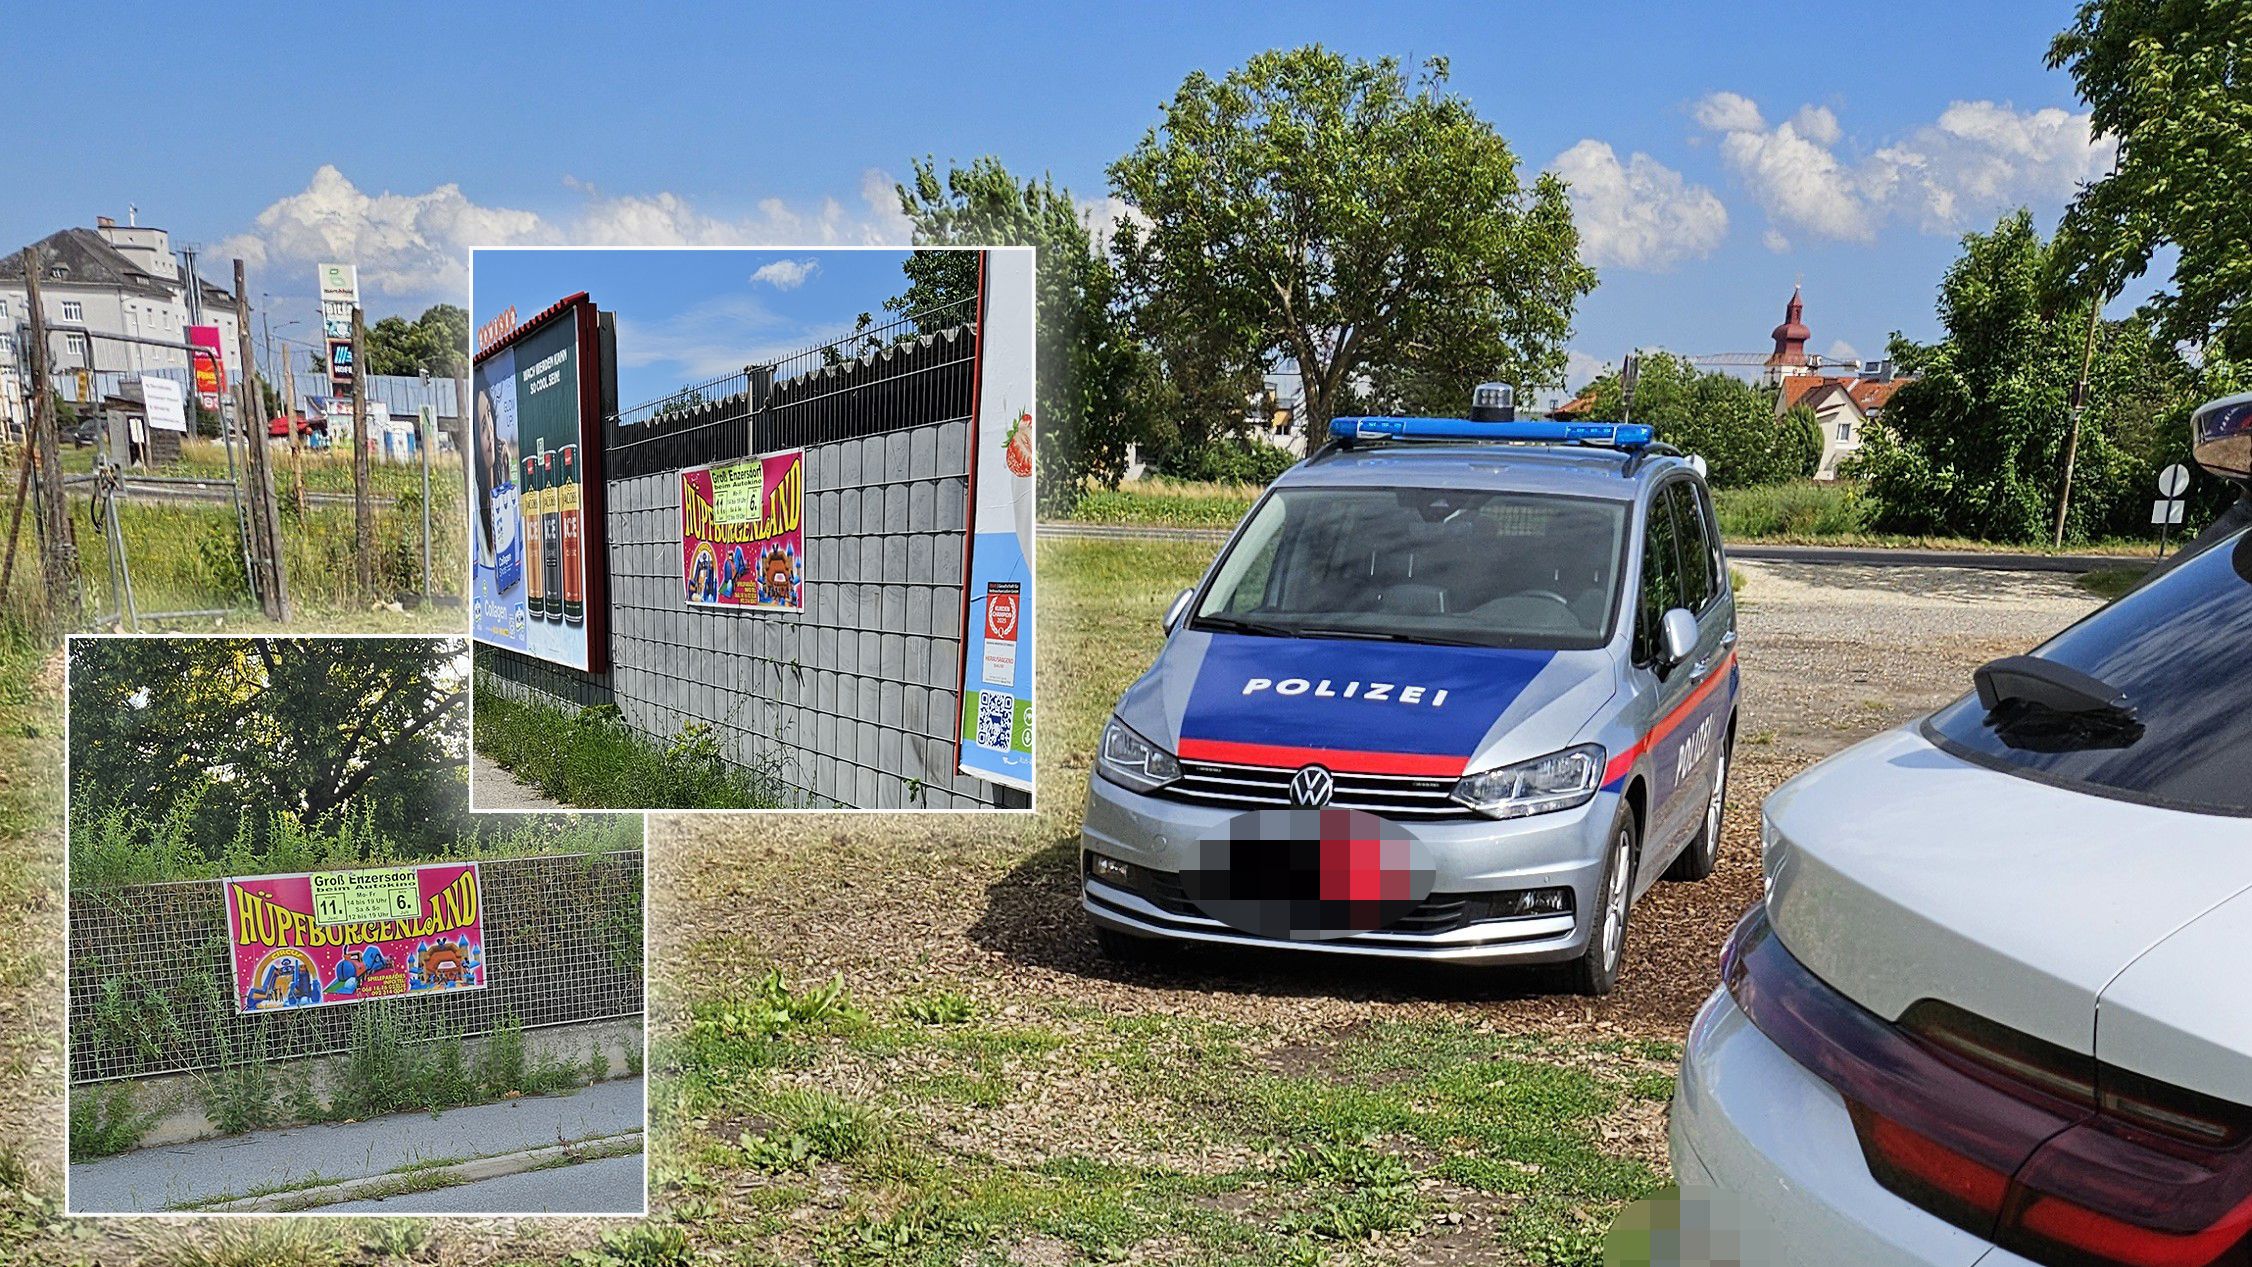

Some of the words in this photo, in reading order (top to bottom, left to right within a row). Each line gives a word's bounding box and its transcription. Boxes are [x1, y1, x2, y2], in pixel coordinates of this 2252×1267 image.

[712, 470, 728, 484] Groß
[728, 464, 762, 481] Enzersdorf
[732, 479, 762, 488] Autokino
[562, 492, 577, 508] JACOBS
[750, 494, 757, 511] 6.
[527, 521, 538, 540] ICE
[544, 519, 556, 540] ICE
[563, 517, 577, 538] ICE
[484, 599, 508, 623] Collagen
[1242, 678, 1449, 707] POLIZEI
[1674, 712, 1713, 787] POLIZEI
[314, 874, 345, 887] Groß
[355, 882, 416, 890] Autokino
[231, 870, 478, 948] HÜPFBURGENLAND
[320, 899, 343, 915] 11.
[396, 894, 411, 910] 6.
[271, 949, 303, 960] CIRCUS
